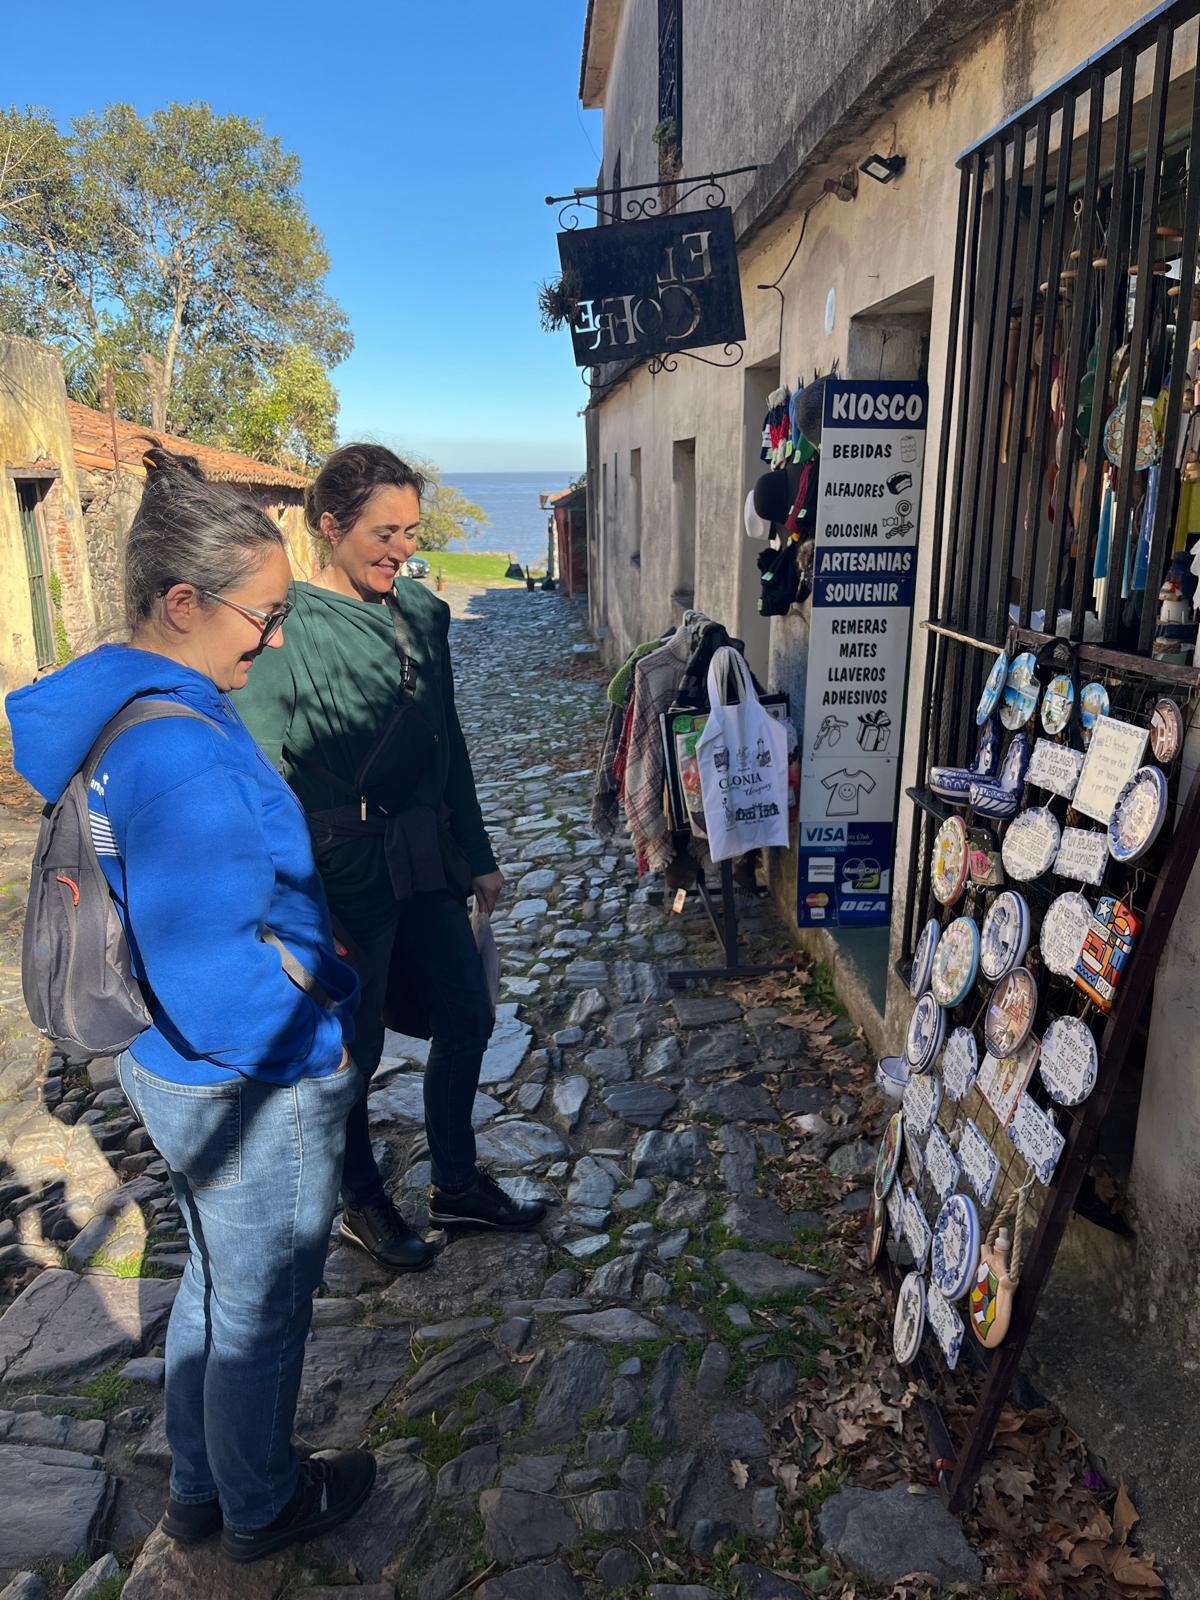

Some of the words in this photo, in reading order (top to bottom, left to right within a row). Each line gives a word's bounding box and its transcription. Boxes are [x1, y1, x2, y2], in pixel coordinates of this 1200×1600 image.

[832, 392, 923, 421] KIOSCO
[832, 444, 892, 459] BEBIDAS
[825, 482, 885, 498] ALFAJORES
[825, 523, 878, 538] GOLOSINA
[820, 552, 911, 573] ARTESANIAS
[825, 583, 898, 602] SOUVENIR
[832, 619, 887, 634] REMERAS
[839, 643, 877, 658] MATES
[828, 667, 886, 682] LLAVEROS
[823, 690, 888, 706] ADHESIVOS
[805, 828, 845, 842] VISA
